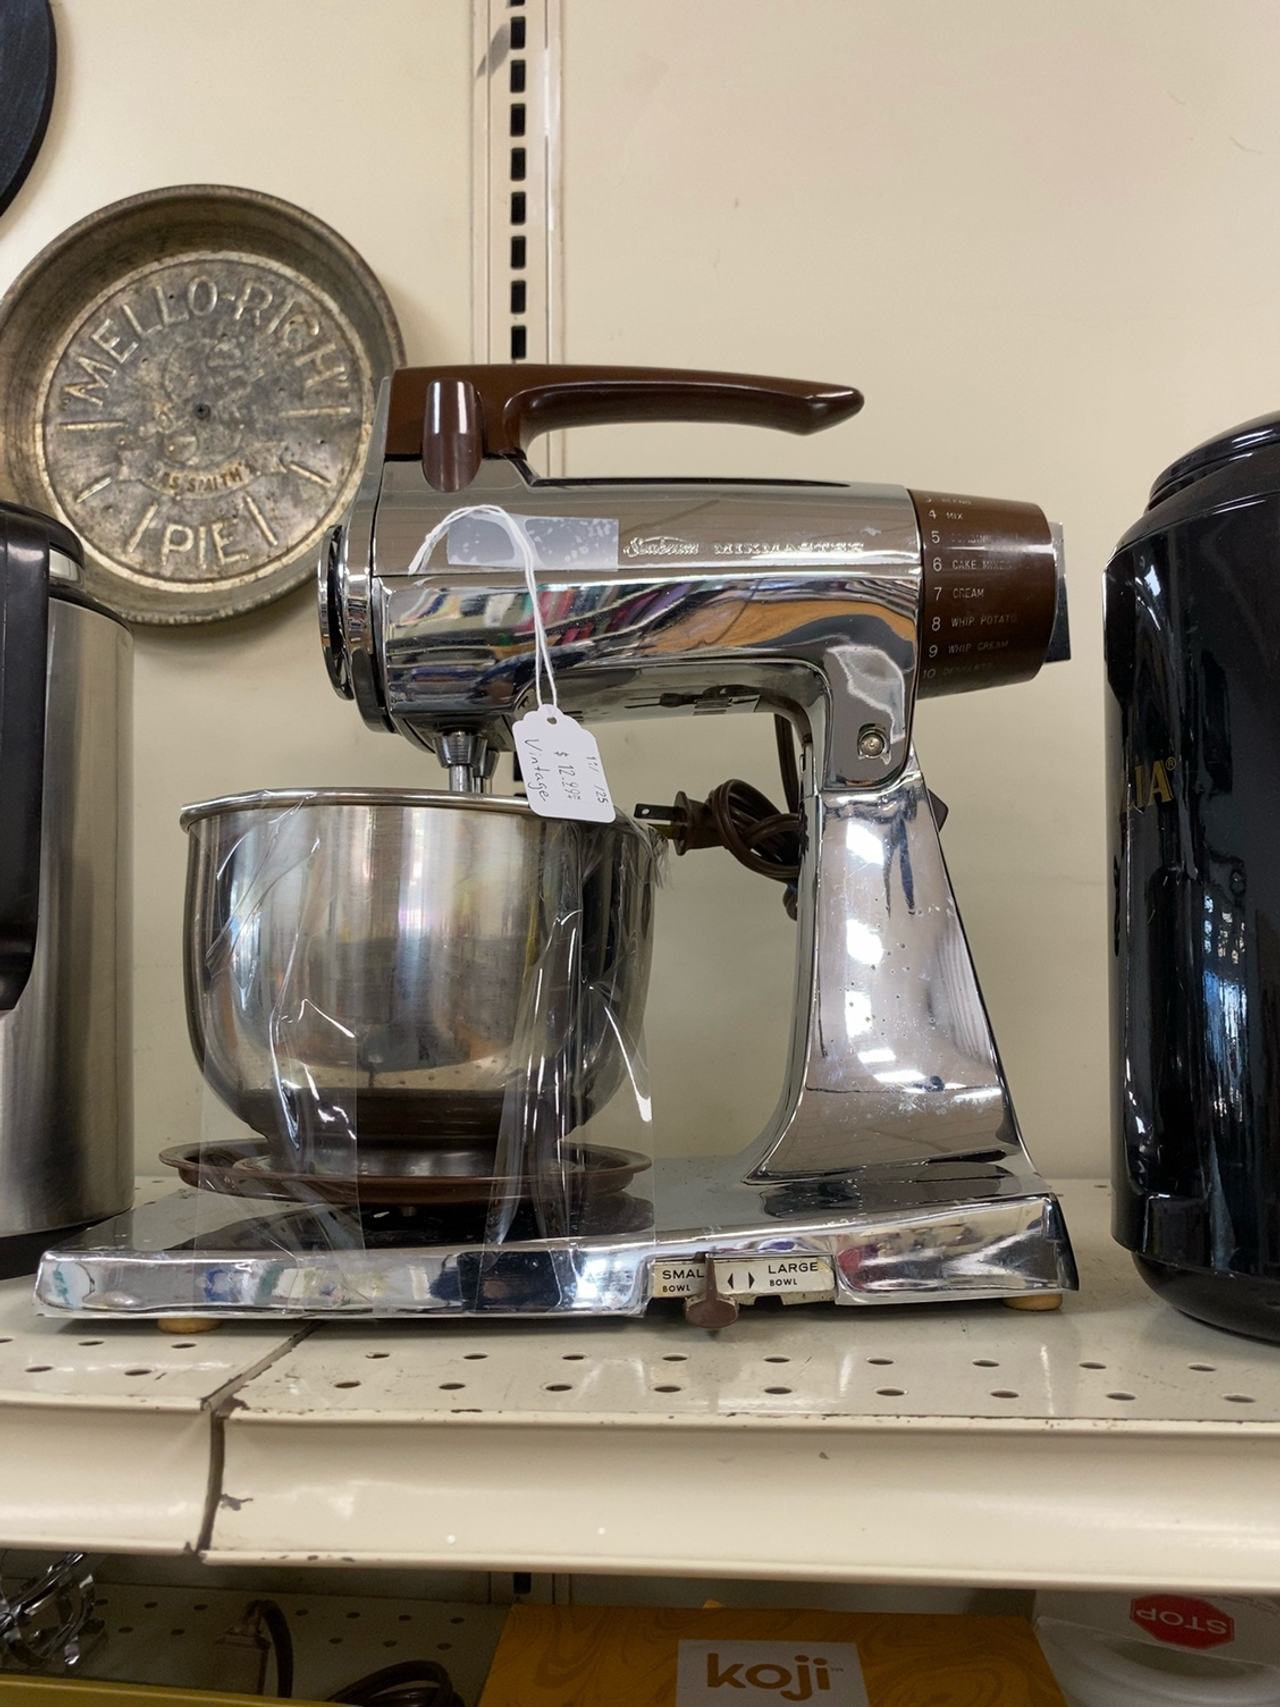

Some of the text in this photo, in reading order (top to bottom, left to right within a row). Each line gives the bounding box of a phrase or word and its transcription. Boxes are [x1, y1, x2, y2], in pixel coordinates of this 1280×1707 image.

[160, 521, 250, 569] PIE
[931, 530, 941, 544] 5
[622, 536, 700, 558] Sunbeam
[932, 557, 942, 572] 6
[952, 560, 977, 570] CAKE
[933, 586, 985, 602] 7 CREAM
[931, 616, 941, 632] 8
[951, 616, 976, 628] WHIP
[928, 640, 1009, 658] 9 WHIP CREAM
[922, 668, 937, 679] 10
[524, 739, 551, 802] Vintage
[662, 1262, 819, 1281] SMAL LARGE
[662, 1278, 798, 1293] BOWL BOWL
[1136, 1607, 1228, 1635] STOP
[707, 1653, 831, 1702] koji
